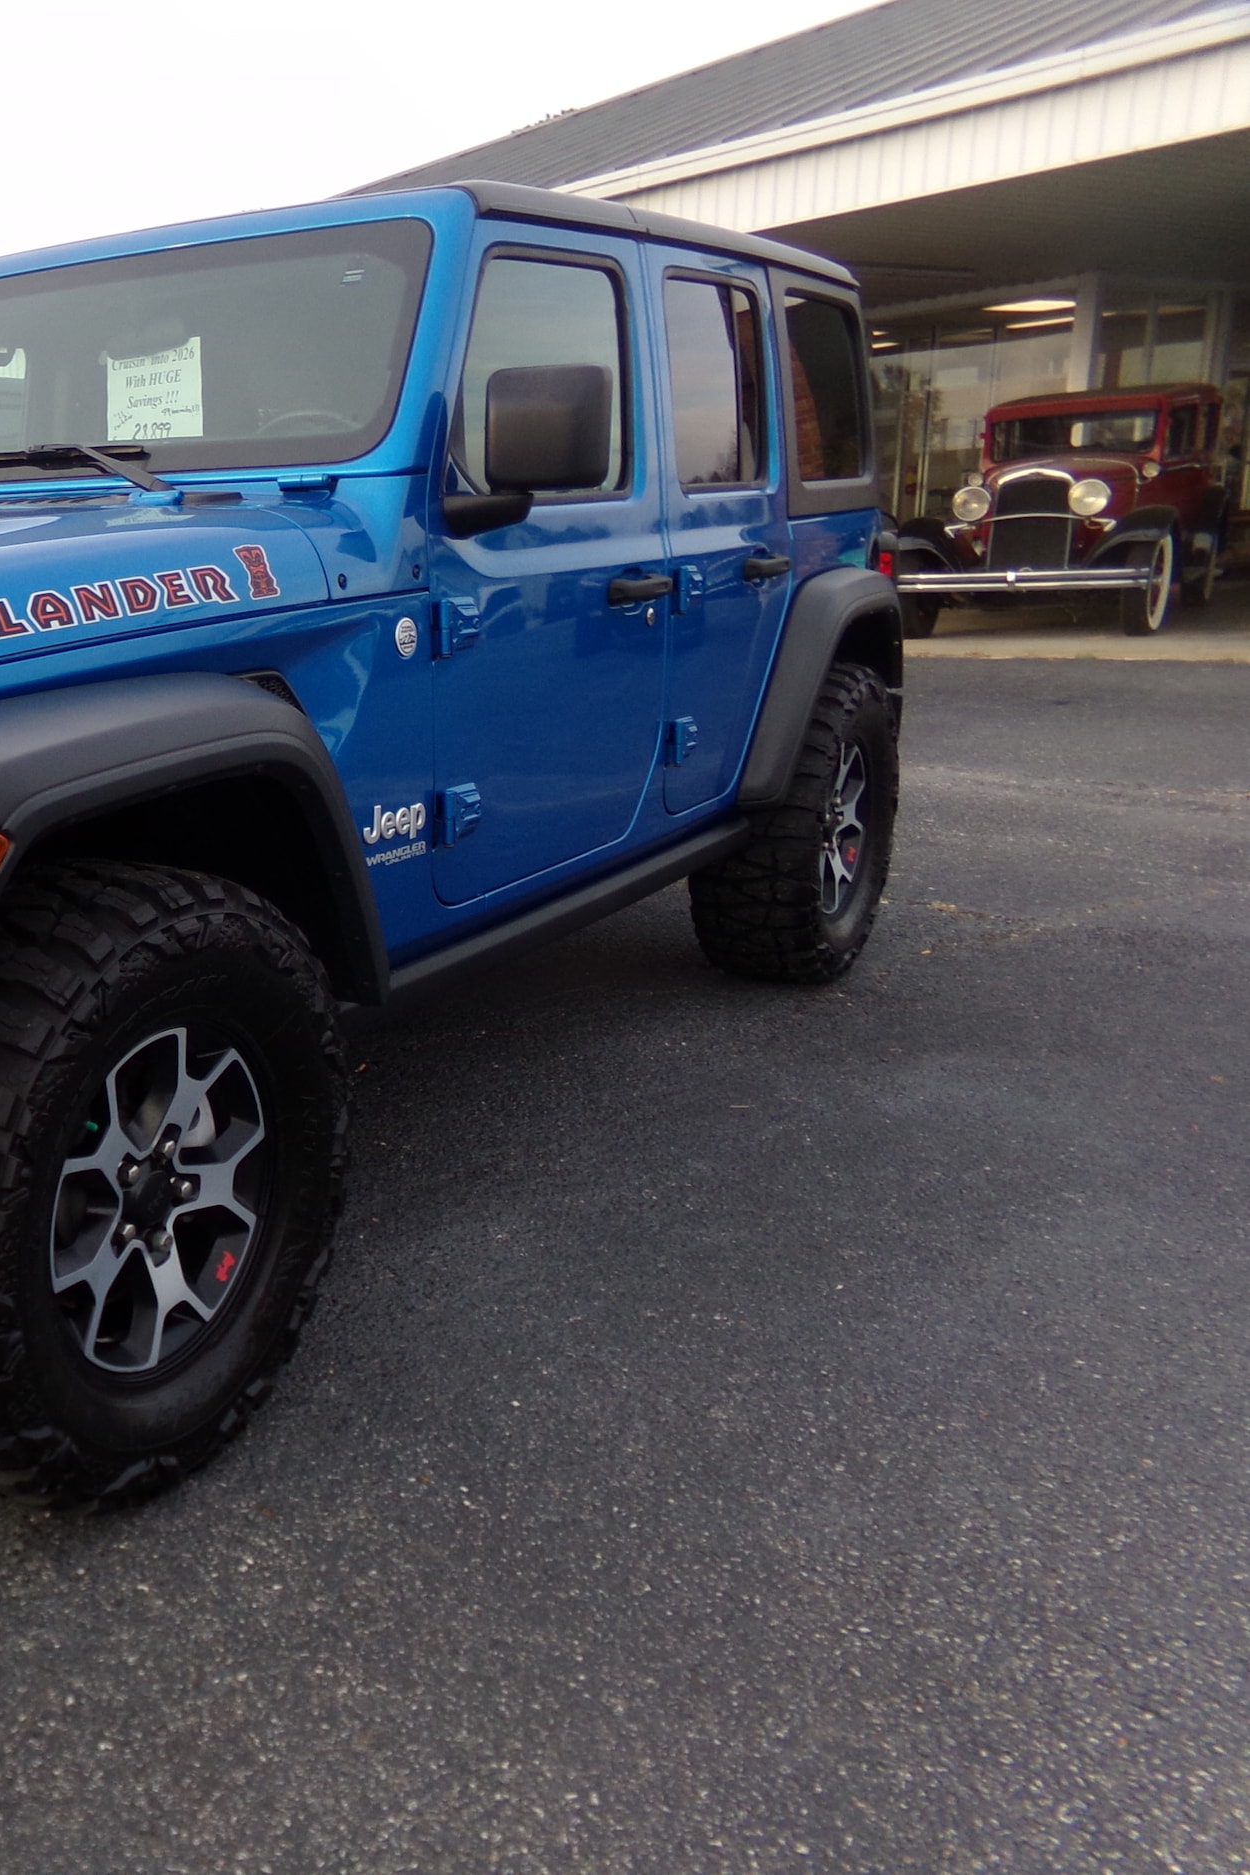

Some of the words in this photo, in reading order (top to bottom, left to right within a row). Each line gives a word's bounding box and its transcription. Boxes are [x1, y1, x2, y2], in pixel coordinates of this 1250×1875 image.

[171, 347, 195, 362] 2026
[126, 375, 147, 388] With
[149, 369, 182, 386] HUGE
[127, 395, 163, 409] Savings
[363, 803, 426, 844] Jeep
[365, 841, 426, 866] WRANGLER
